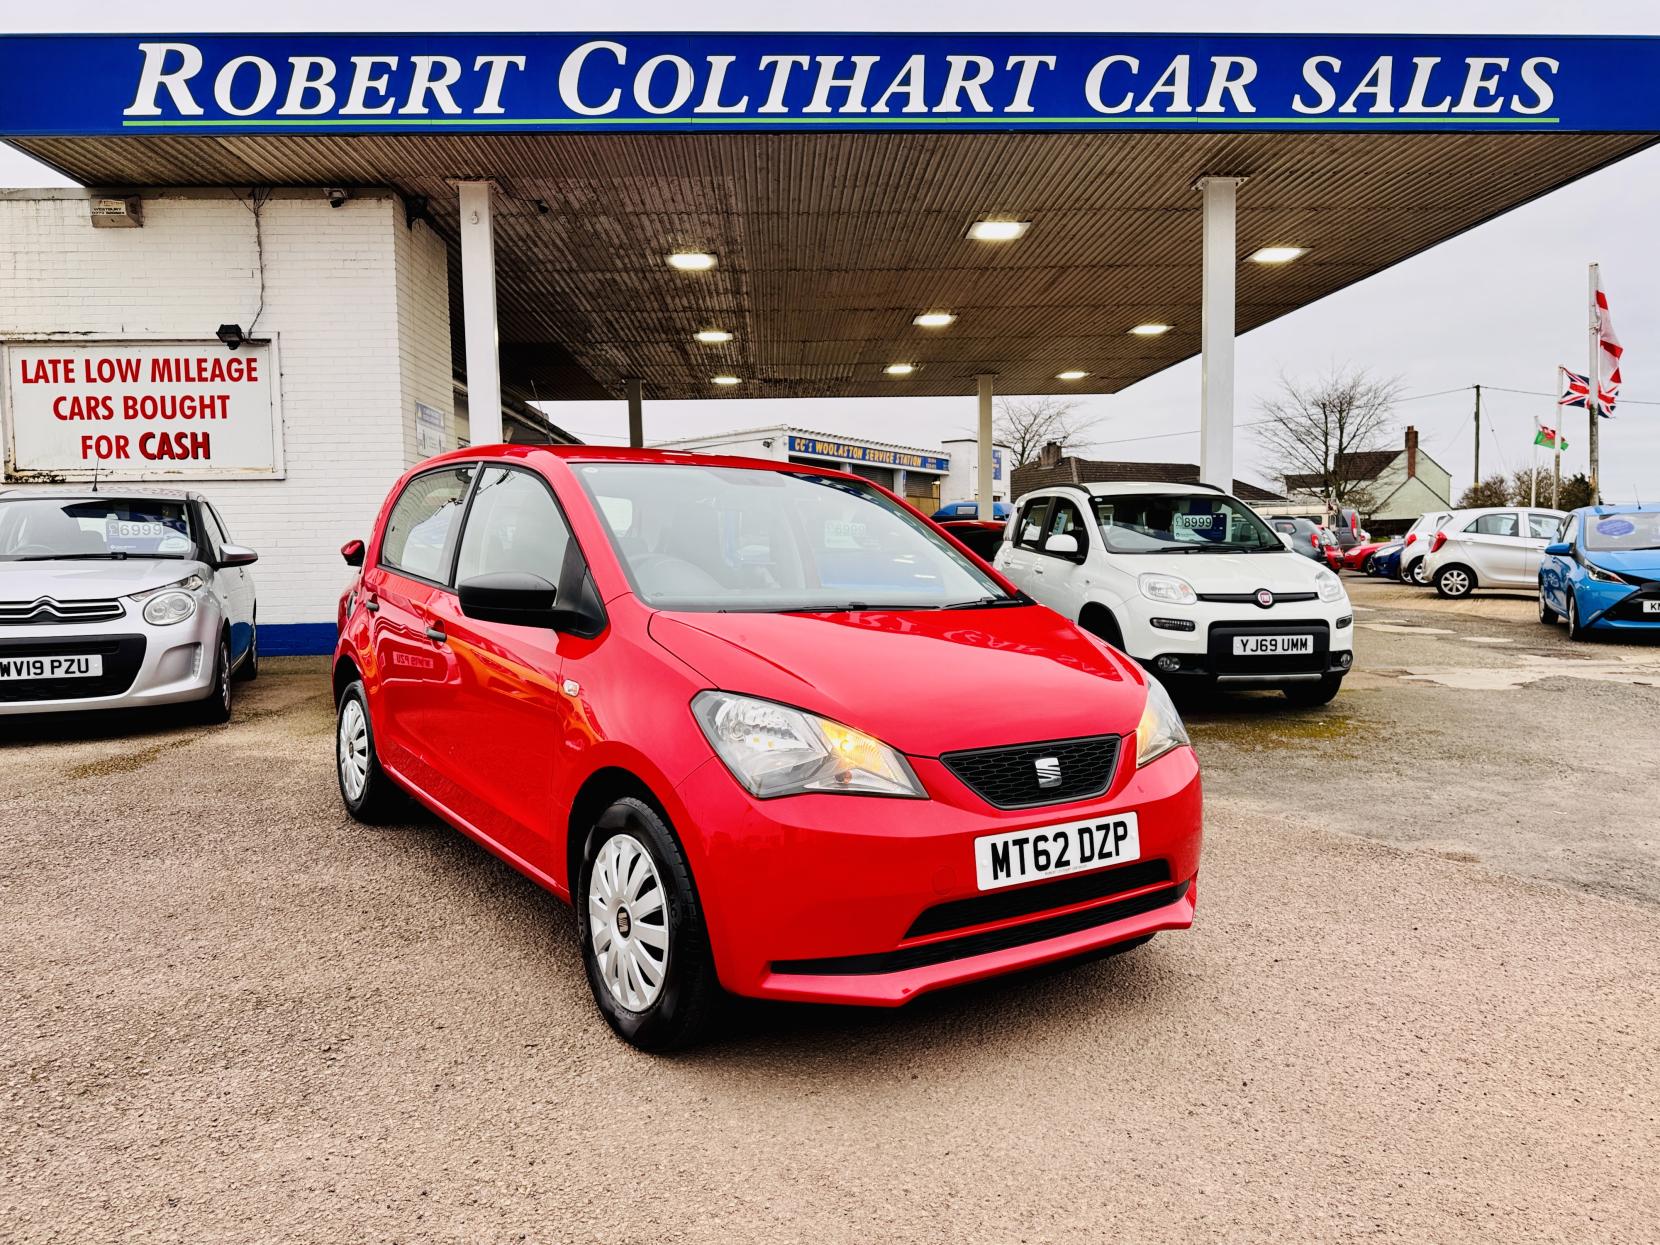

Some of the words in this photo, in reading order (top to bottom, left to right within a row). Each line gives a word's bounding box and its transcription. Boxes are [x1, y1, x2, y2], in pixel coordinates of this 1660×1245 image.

[1084, 54, 1257, 114] CAR
[1291, 55, 1560, 115] SALES
[21, 358, 75, 384] LATE
[84, 358, 141, 384] LOW
[150, 357, 259, 383] MILEAGE
[52, 395, 114, 421] CARS
[123, 394, 231, 420] BOUGHT
[80, 435, 130, 460] FOR
[138, 431, 211, 461] CASH
[815, 441, 863, 459] WOOLASTON
[865, 448, 894, 464] SERVICE
[896, 453, 921, 468] STATION
[1240, 638, 1278, 653] YJ69
[1281, 637, 1308, 652] UMM
[0, 660, 44, 677] WV19
[50, 658, 89, 675] PZU
[990, 831, 1071, 881] MT62
[1077, 820, 1128, 864] DZP
